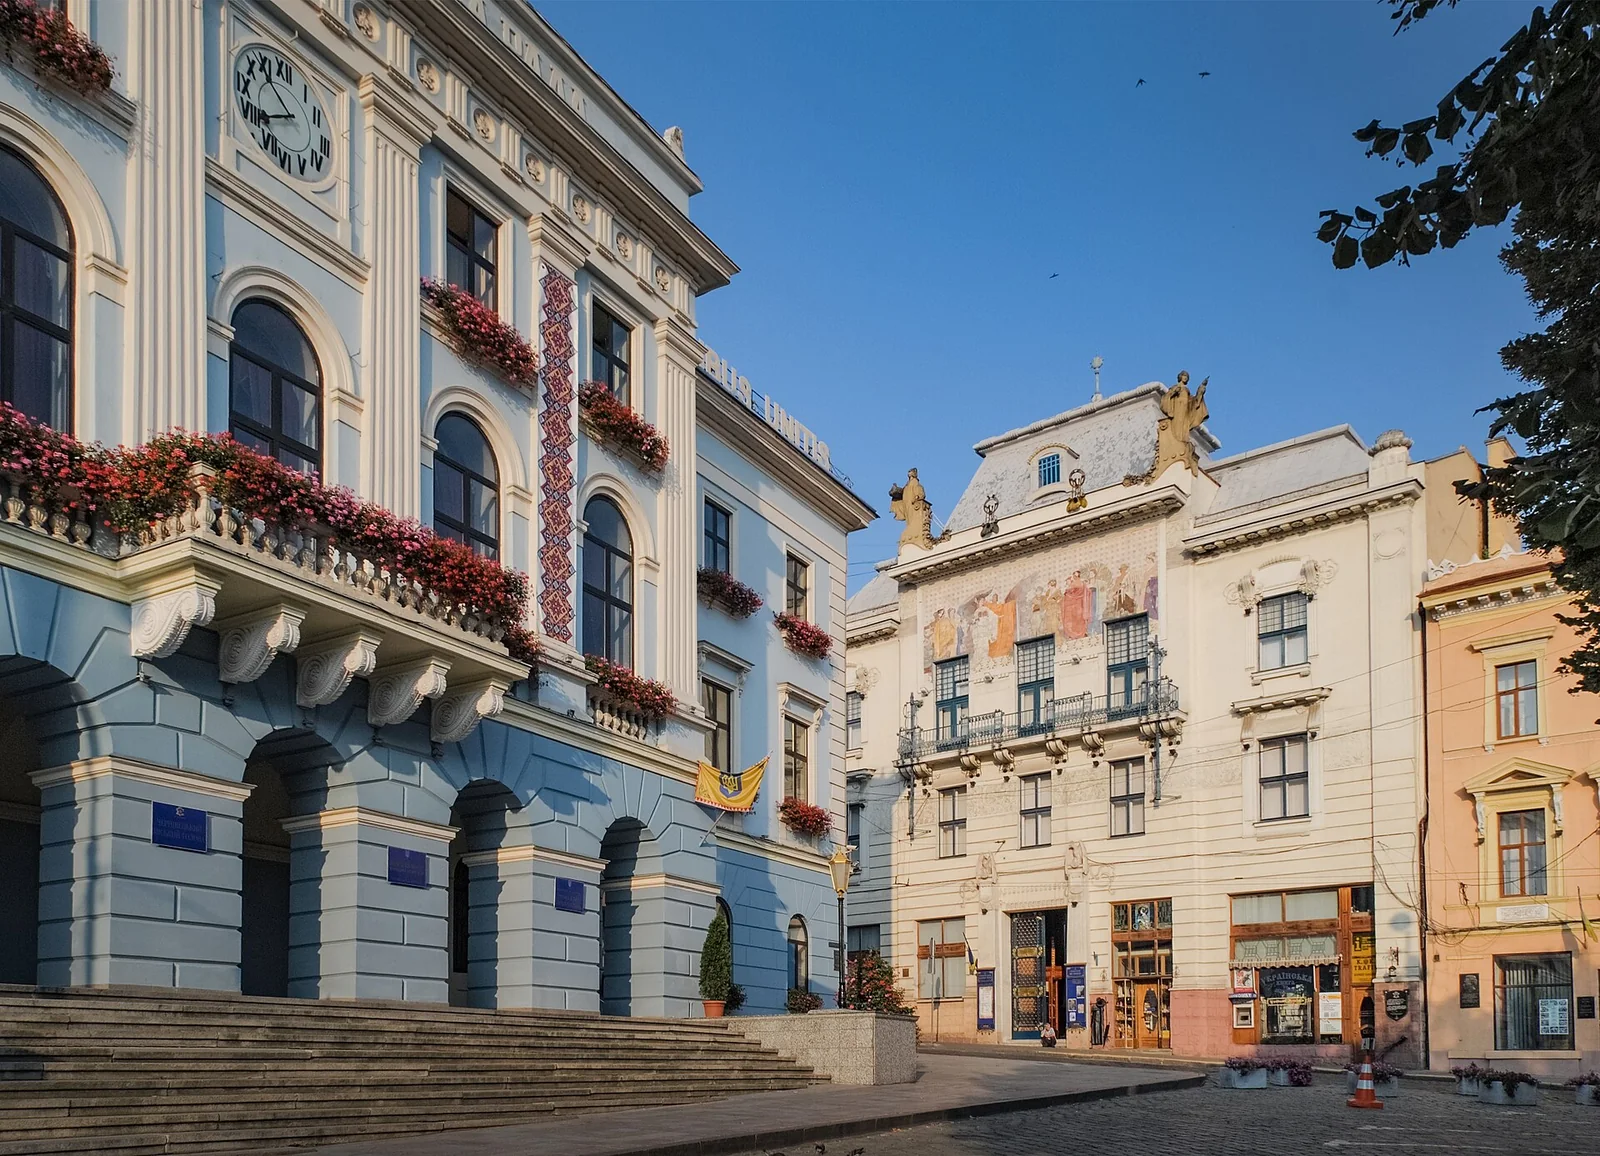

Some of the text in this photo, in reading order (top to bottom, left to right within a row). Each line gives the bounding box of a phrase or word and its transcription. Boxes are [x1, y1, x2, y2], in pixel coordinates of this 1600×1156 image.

[247, 55, 256, 81] X
[275, 56, 292, 86] XII
[237, 71, 251, 99] IX
[313, 106, 320, 128] II
[261, 128, 277, 157] VII
[320, 135, 330, 158] III
[278, 147, 291, 174] VI
[297, 154, 307, 176] V
[310, 148, 323, 172] IV
